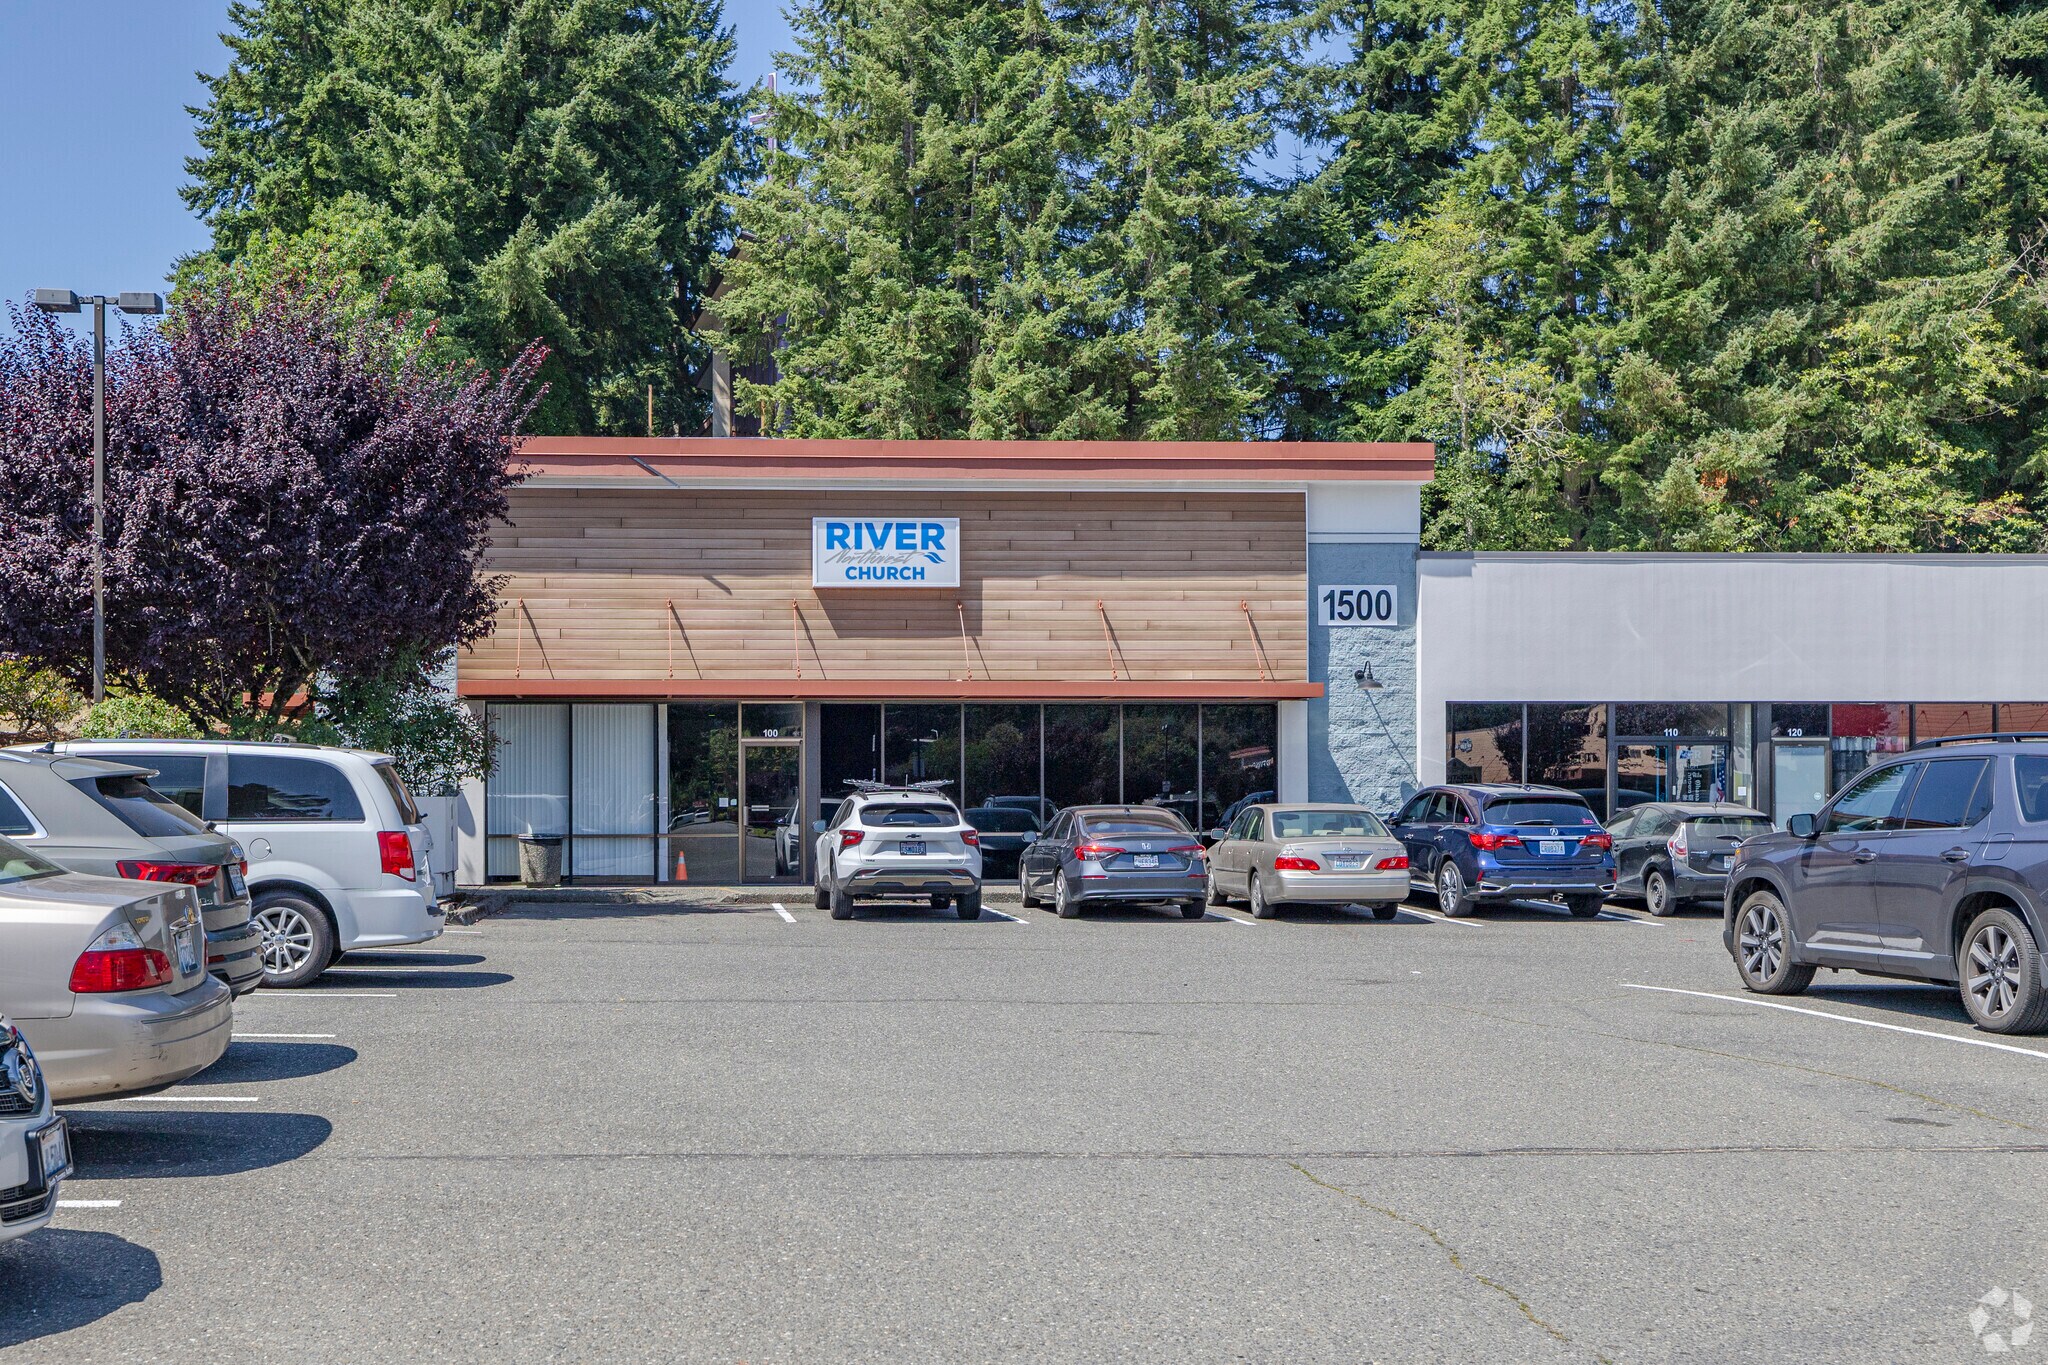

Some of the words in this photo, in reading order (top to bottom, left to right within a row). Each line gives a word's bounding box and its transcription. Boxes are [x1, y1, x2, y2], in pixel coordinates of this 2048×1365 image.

[826, 522, 945, 551] RIVER
[824, 544, 925, 565] Northwest
[845, 566, 925, 581] CHURCH
[1323, 589, 1392, 621] 1500
[763, 729, 778, 738] 100
[1663, 728, 1679, 737] 110
[1787, 728, 1803, 737] 120
